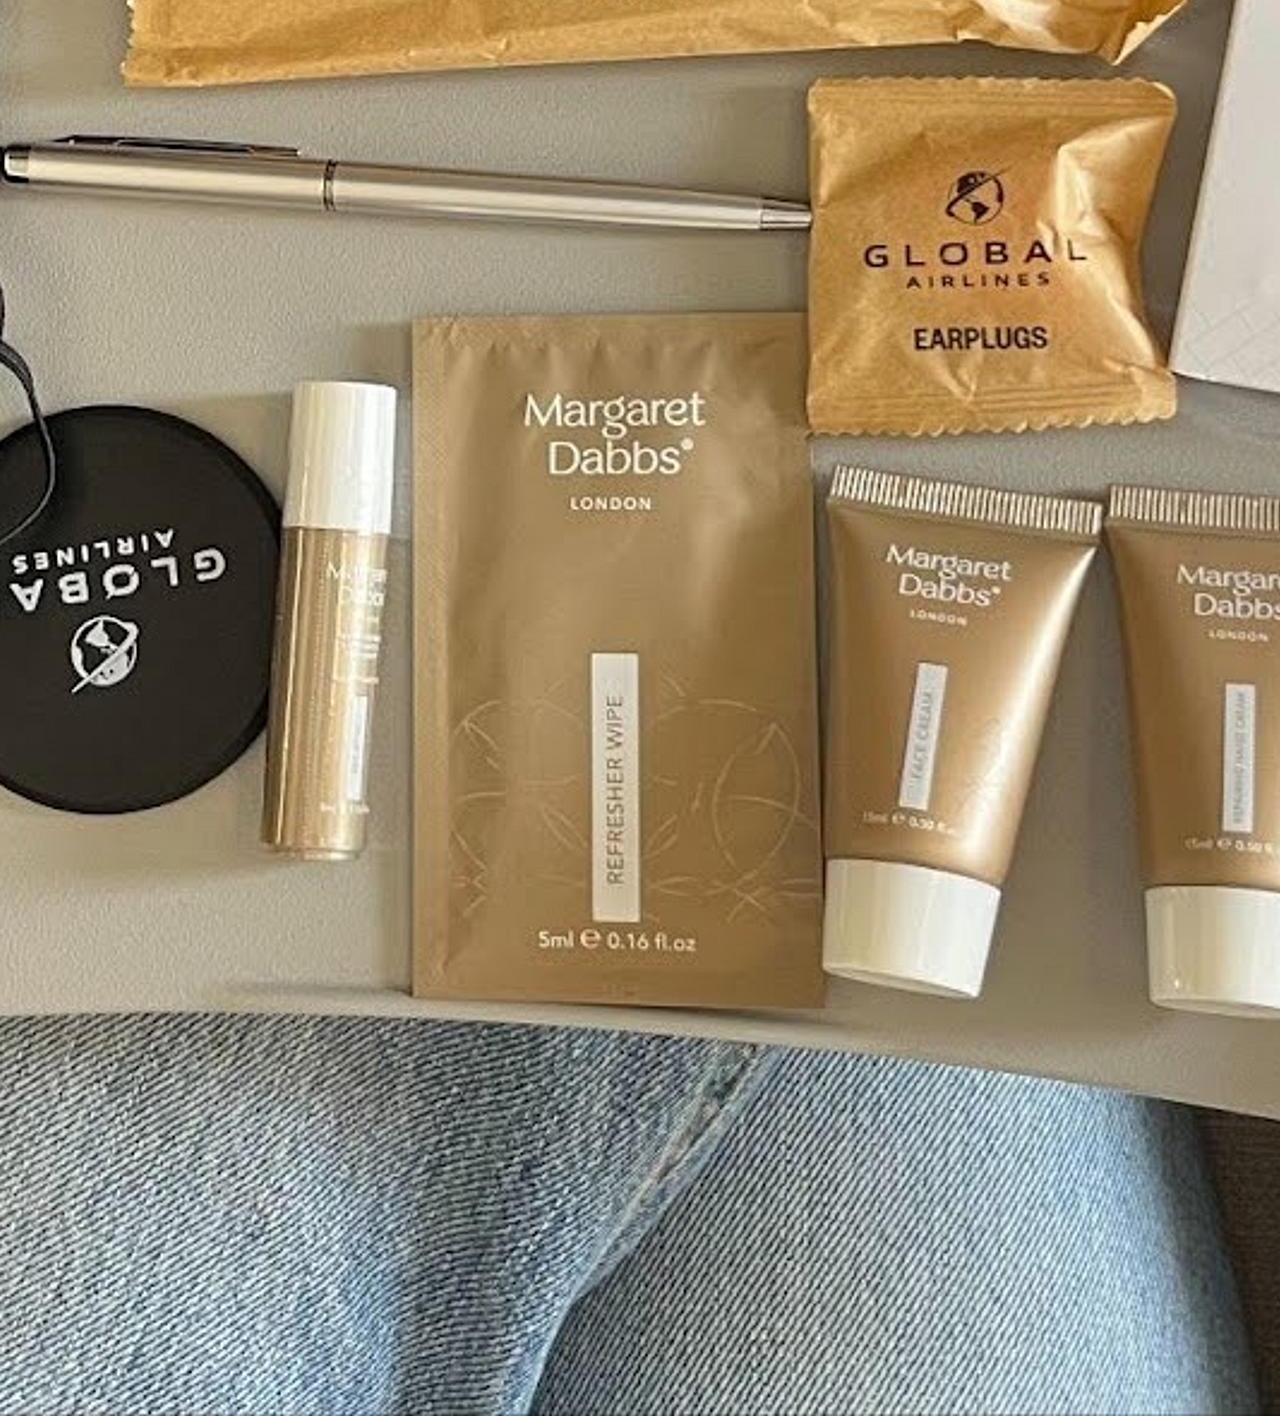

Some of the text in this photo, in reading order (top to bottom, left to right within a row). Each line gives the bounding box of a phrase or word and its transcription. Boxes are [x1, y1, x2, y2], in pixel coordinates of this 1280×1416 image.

[863, 238, 1089, 269] GLOBAL
[906, 271, 1051, 289] AIRLINES
[913, 325, 1048, 351] EARPLUGS
[523, 391, 707, 440] Margaret
[569, 495, 653, 512] LONDON
[11, 528, 175, 575] AIRLINES
[885, 543, 1013, 583] Margaret
[909, 608, 968, 628] LONDON
[1208, 628, 1269, 643] LONDON
[606, 695, 626, 885] REFRESHER WIPE
[537, 929, 574, 949] 5ml
[606, 931, 650, 951] 0.16
[654, 930, 698, 953] fl.oz
